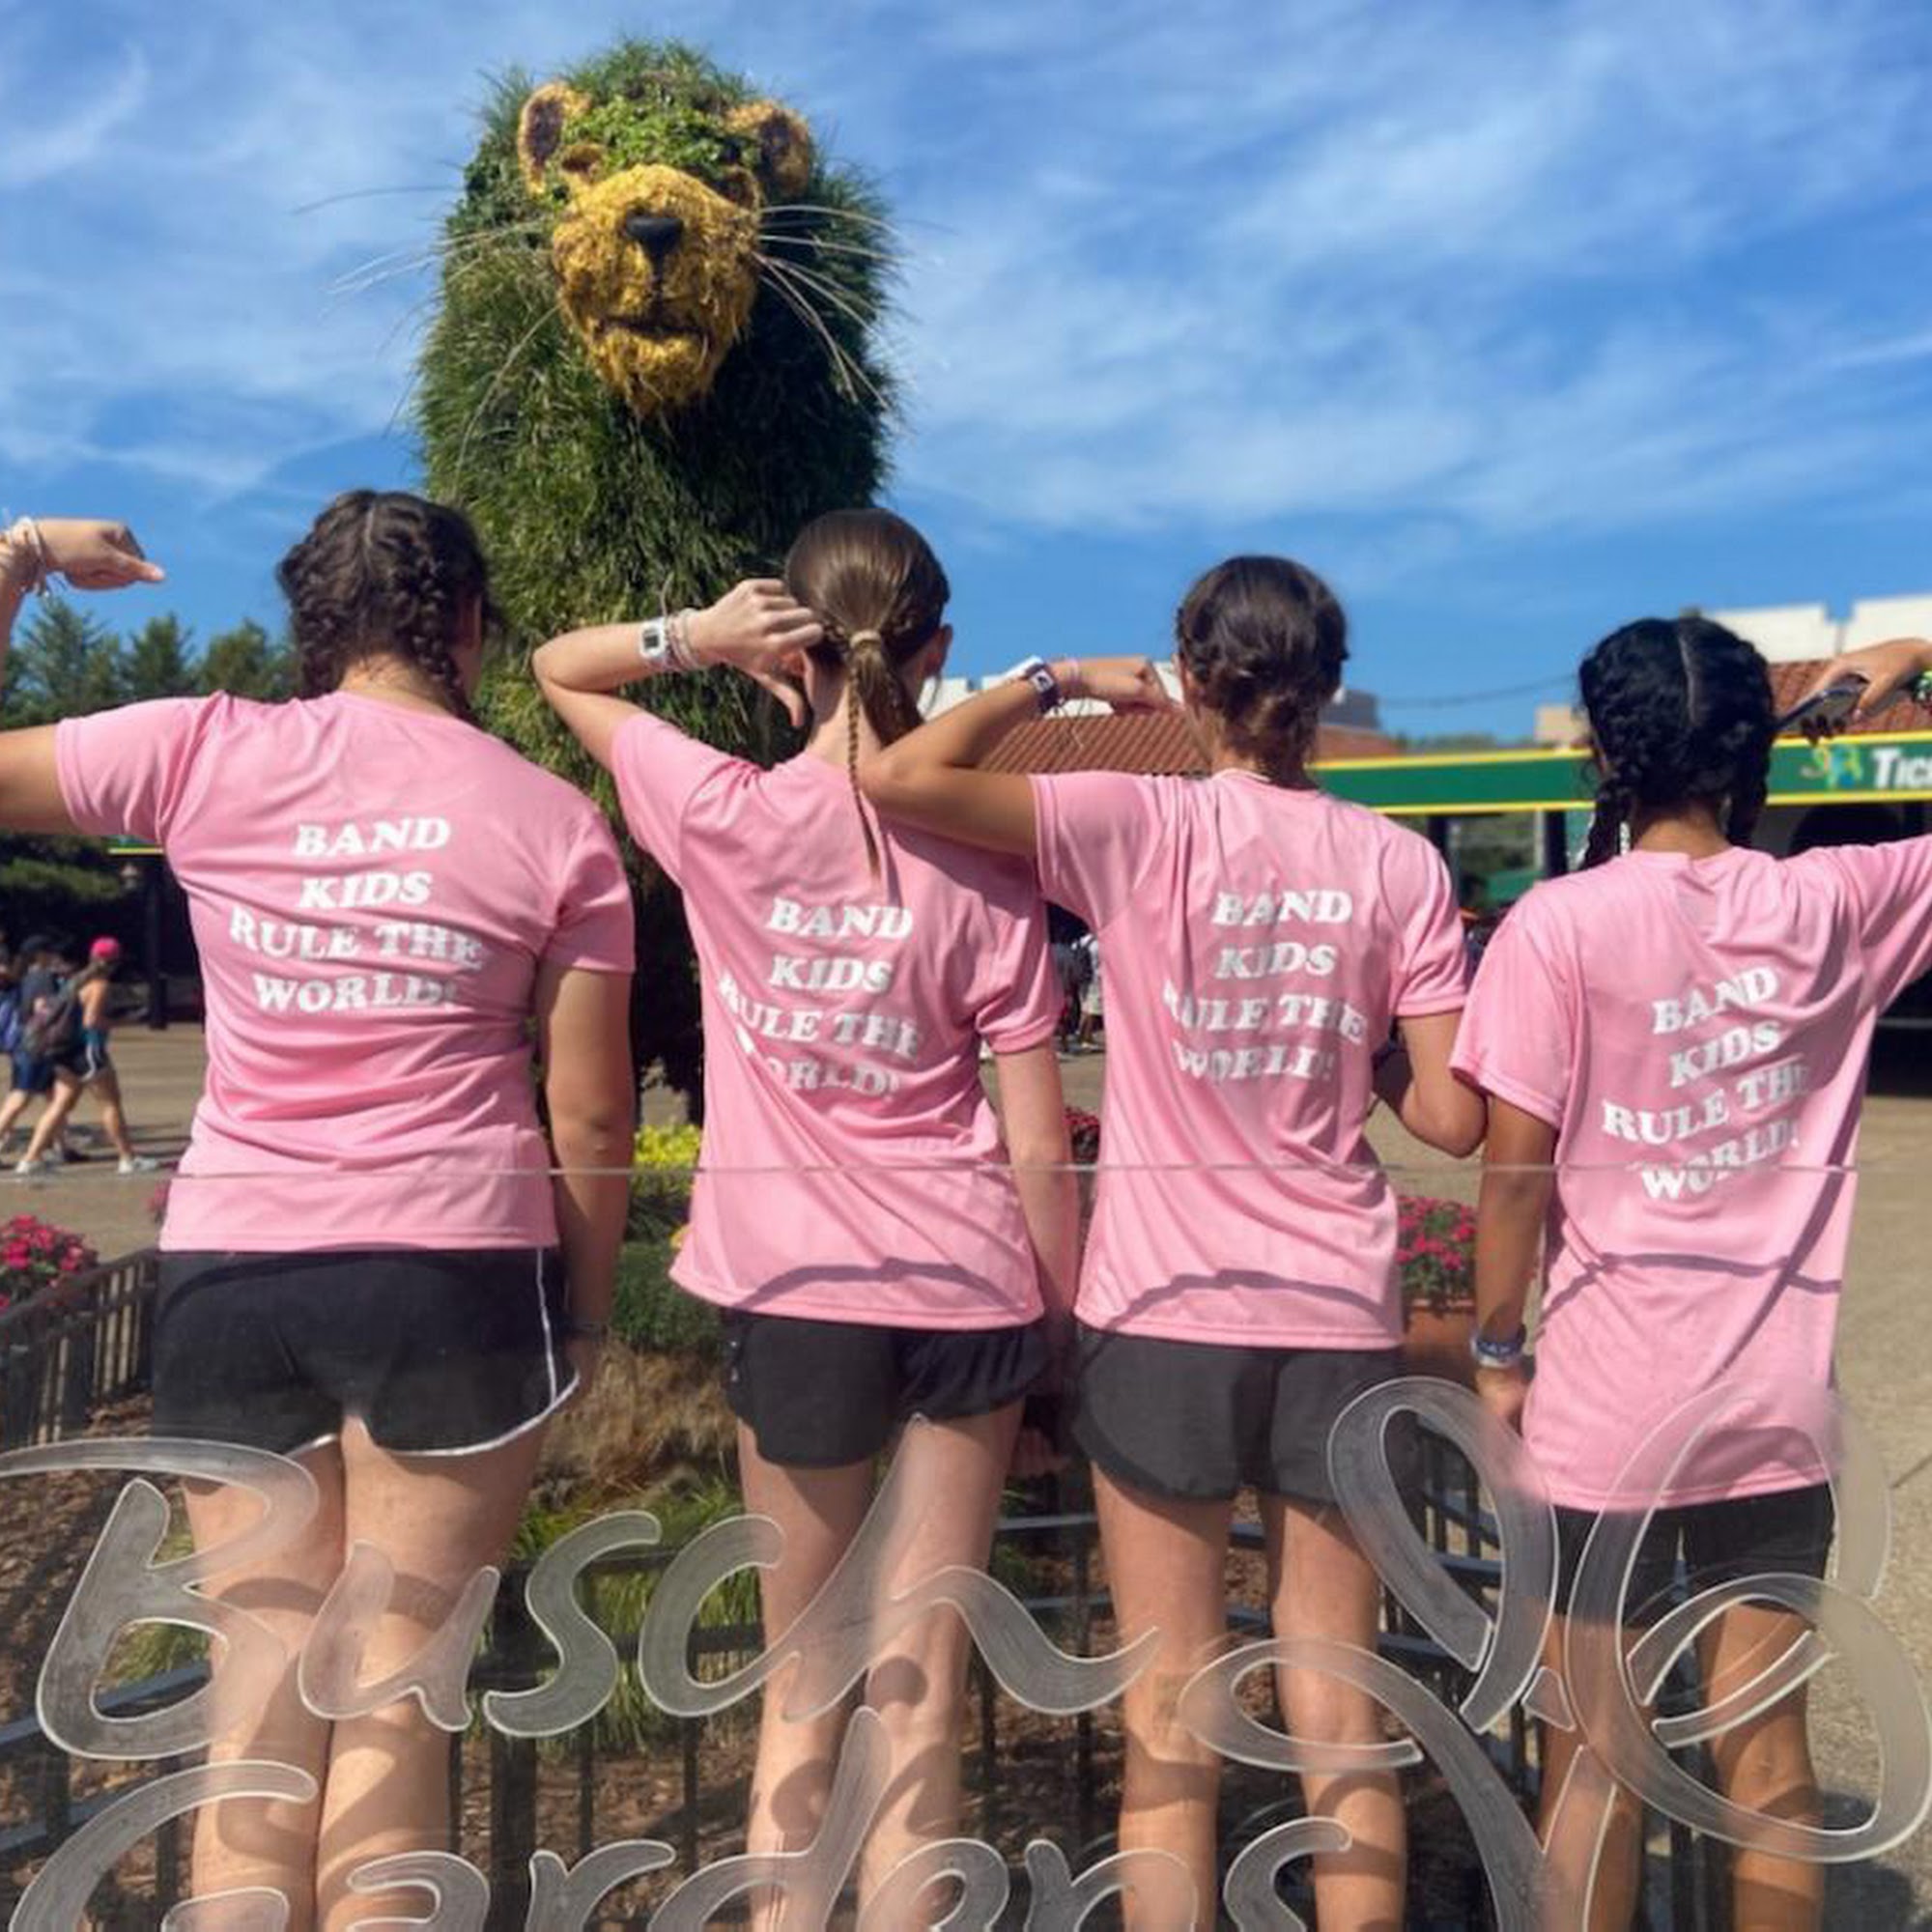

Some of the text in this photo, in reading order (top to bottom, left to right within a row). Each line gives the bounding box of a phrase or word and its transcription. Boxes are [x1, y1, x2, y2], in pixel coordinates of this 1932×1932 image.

[293, 816, 450, 858] BAND
[297, 871, 433, 909] KIDS
[1211, 890, 1352, 926] BAND
[229, 905, 358, 959] RULE
[766, 896, 914, 940] BAND
[768, 954, 894, 993] KIDS
[1214, 942, 1339, 980] KIDS
[1652, 966, 1778, 1035] BAND
[1670, 1020, 1781, 1088] KIDS
[1602, 1088, 1730, 1145] RULE
[0, 1410, 1159, 1759] Busch
